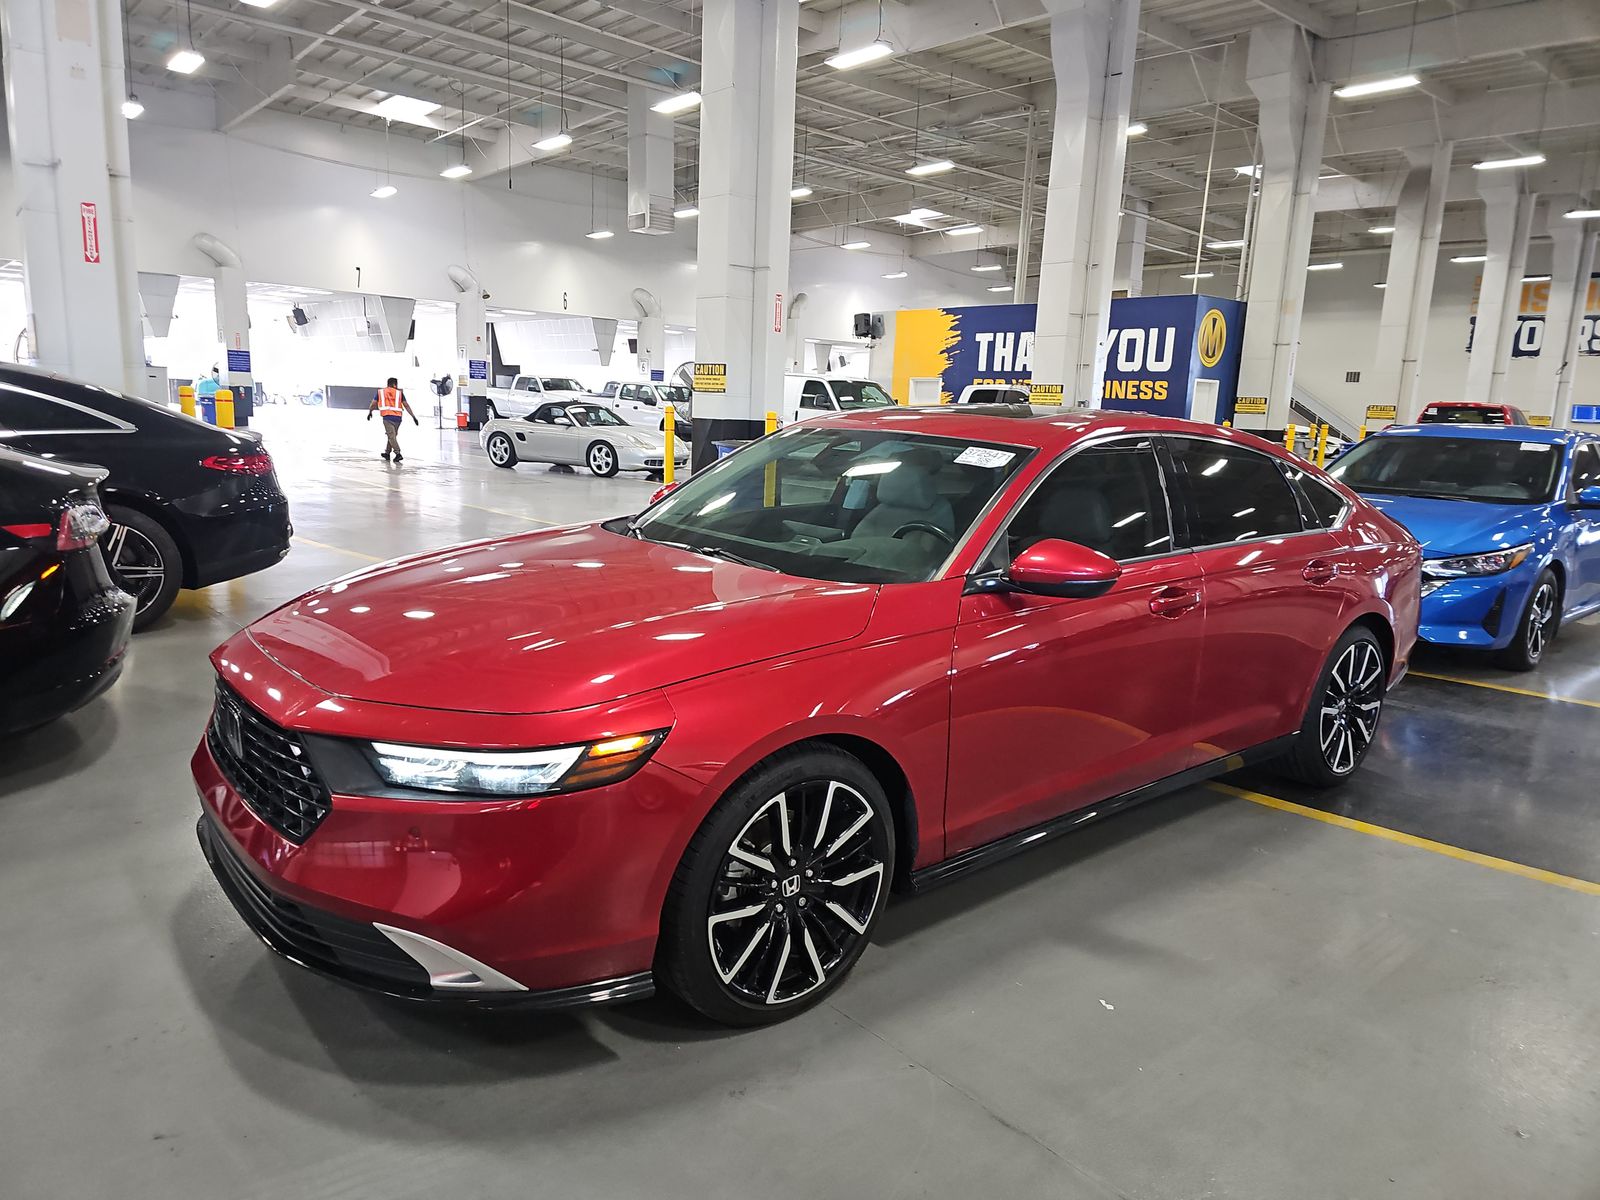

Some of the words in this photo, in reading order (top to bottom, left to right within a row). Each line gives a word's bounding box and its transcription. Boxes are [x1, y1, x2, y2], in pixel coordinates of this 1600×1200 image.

[563, 291, 568, 311] 6
[975, 331, 1034, 372] THA
[695, 364, 725, 375] CAUTION
[1031, 384, 1062, 393] CAUTION
[1104, 380, 1169, 400] INESS
